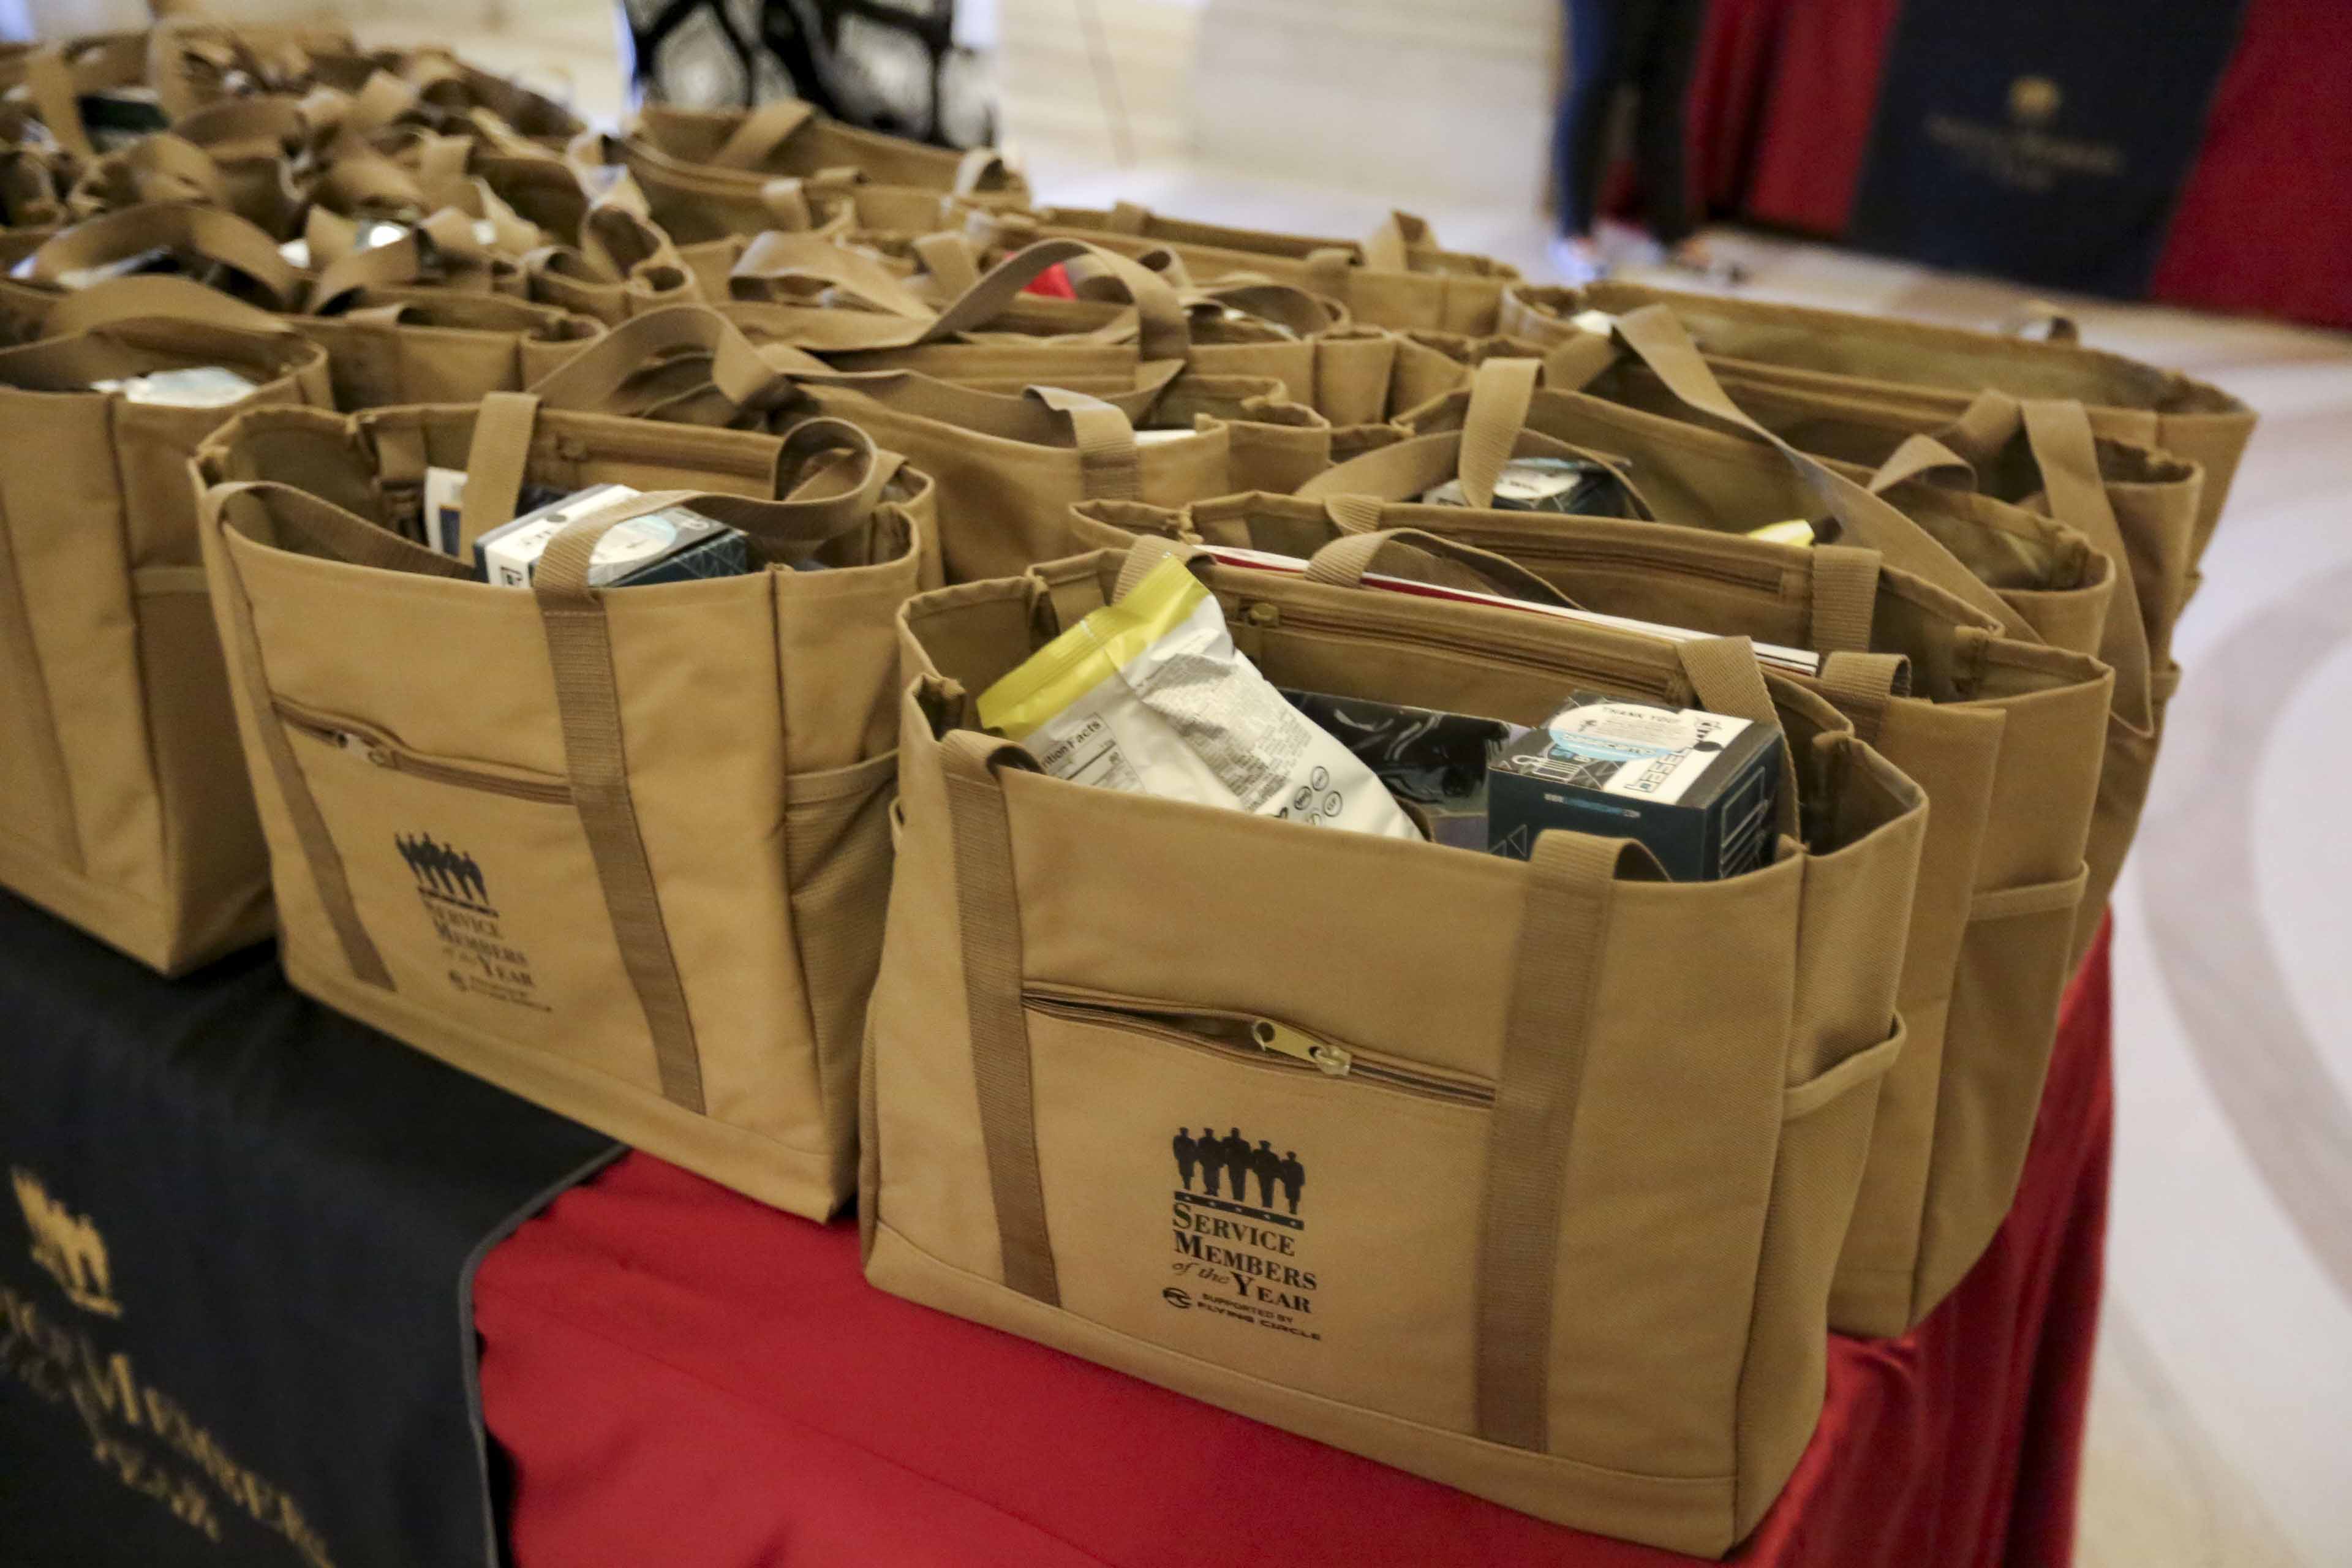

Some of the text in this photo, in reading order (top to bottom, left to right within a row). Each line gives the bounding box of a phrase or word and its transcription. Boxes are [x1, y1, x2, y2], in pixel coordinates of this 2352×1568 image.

[1172, 1202, 1295, 1256] SERVICE
[1173, 1229, 1317, 1291] MEMBERS
[1172, 1262, 1313, 1314] of the YEAR
[1202, 1292, 1294, 1324] SUPPORTED BY
[1197, 1302, 1322, 1341] FLYING CIRCLE
